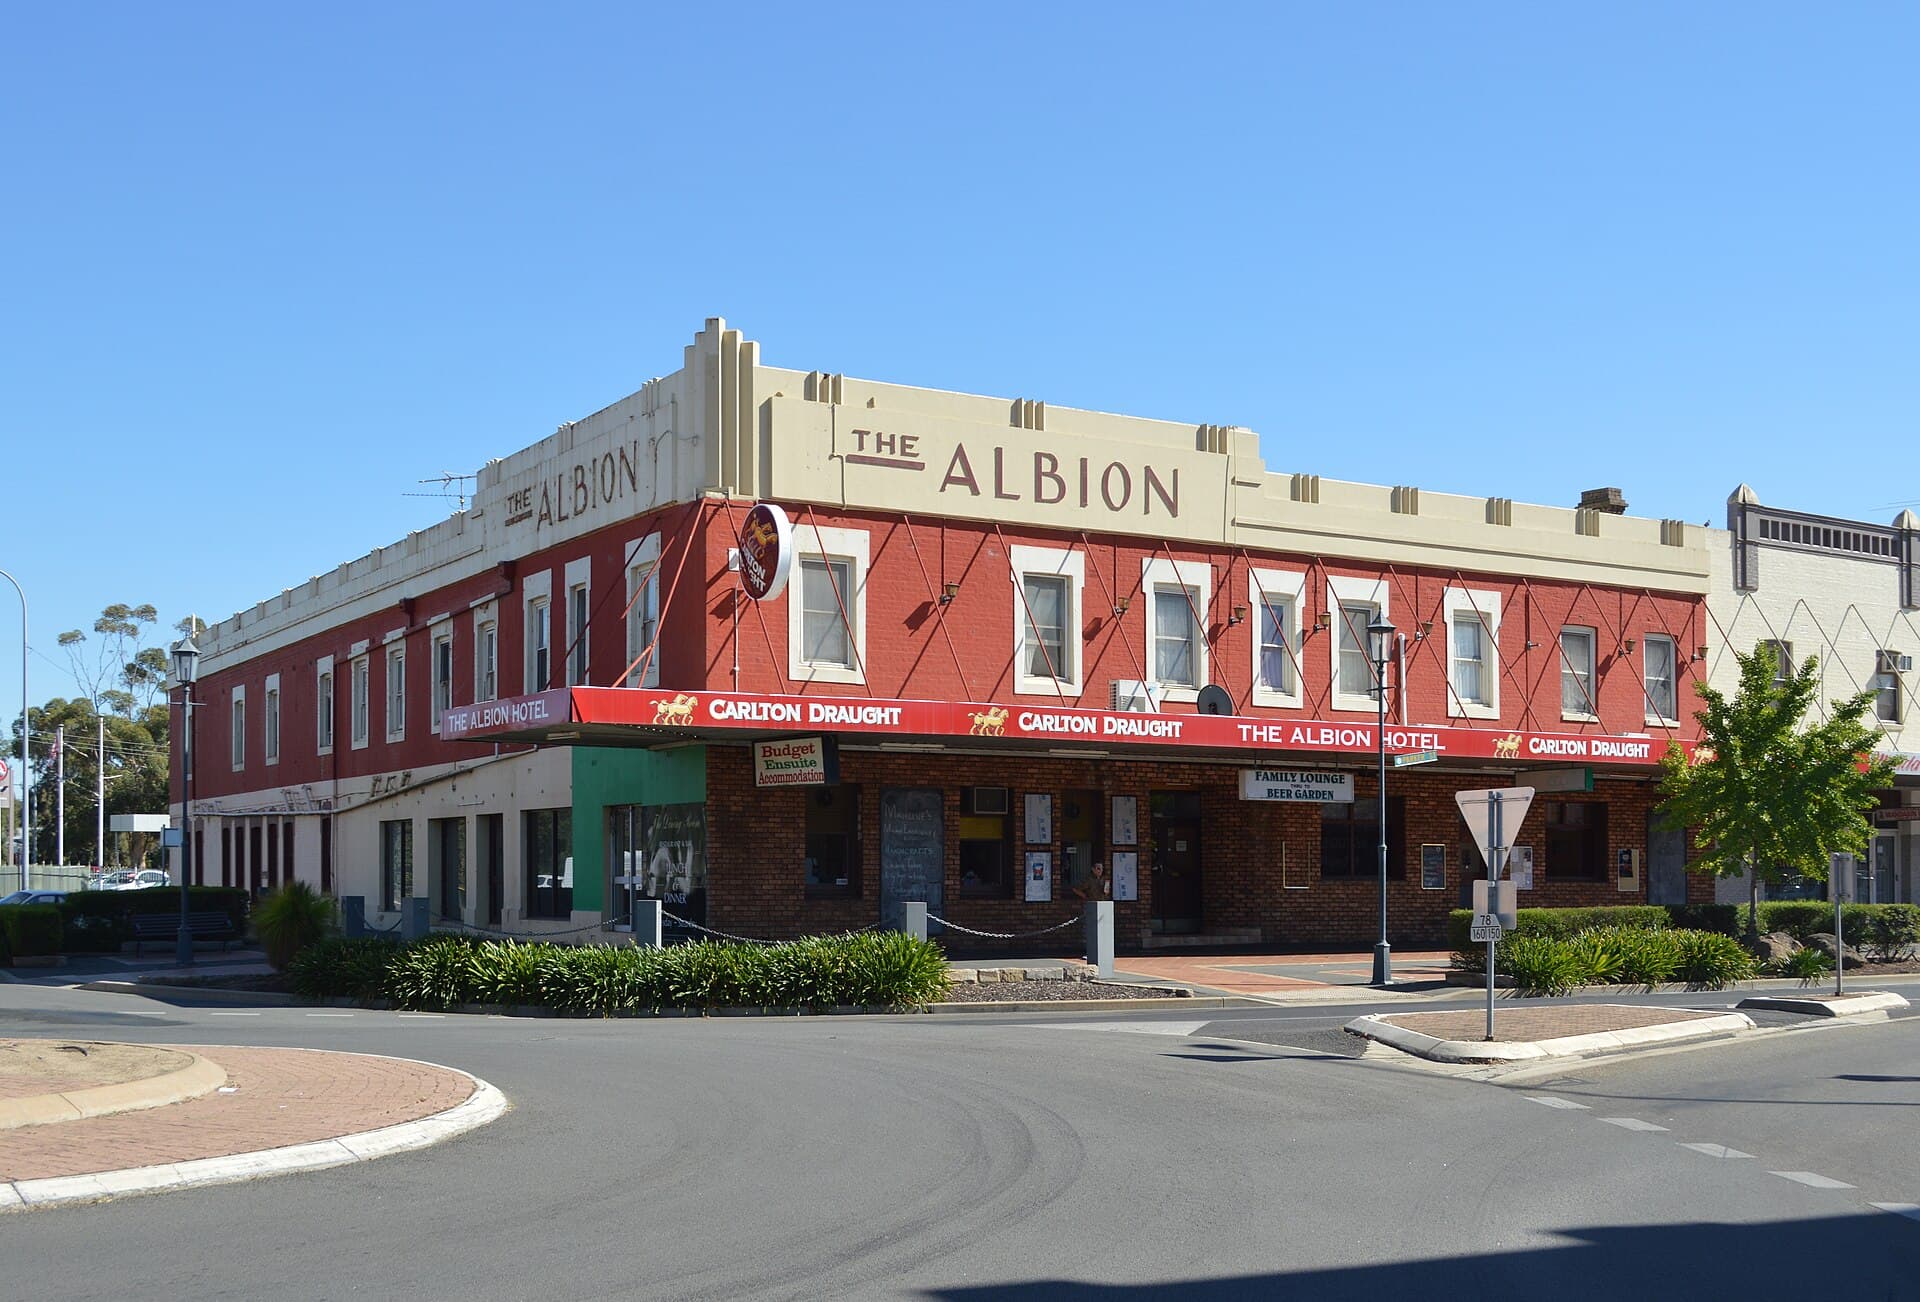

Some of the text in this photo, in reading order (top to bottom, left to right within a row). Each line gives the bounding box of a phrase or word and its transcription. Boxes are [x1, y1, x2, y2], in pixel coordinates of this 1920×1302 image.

[851, 429, 1178, 518] THE ALBION
[507, 440, 638, 532] THE ALBION
[448, 699, 549, 733] THE ALBION HOTEL
[709, 699, 902, 725] CARLTON DRAUGHT
[1018, 712, 1183, 738] CARLTON DRAUGHT
[1237, 724, 1446, 750] THE ALBION HOTEL
[762, 743, 815, 759] Budget
[1529, 738, 1650, 758] CARLTON DRAUGHT
[764, 758, 817, 770] Ensuite
[758, 770, 825, 785] Accommodation
[1255, 771, 1345, 785] FAMILY LOUNGE
[1267, 788, 1334, 801] BEER GARDEN
[1480, 914, 1492, 926] 78
[1472, 928, 1501, 941] 160 150
